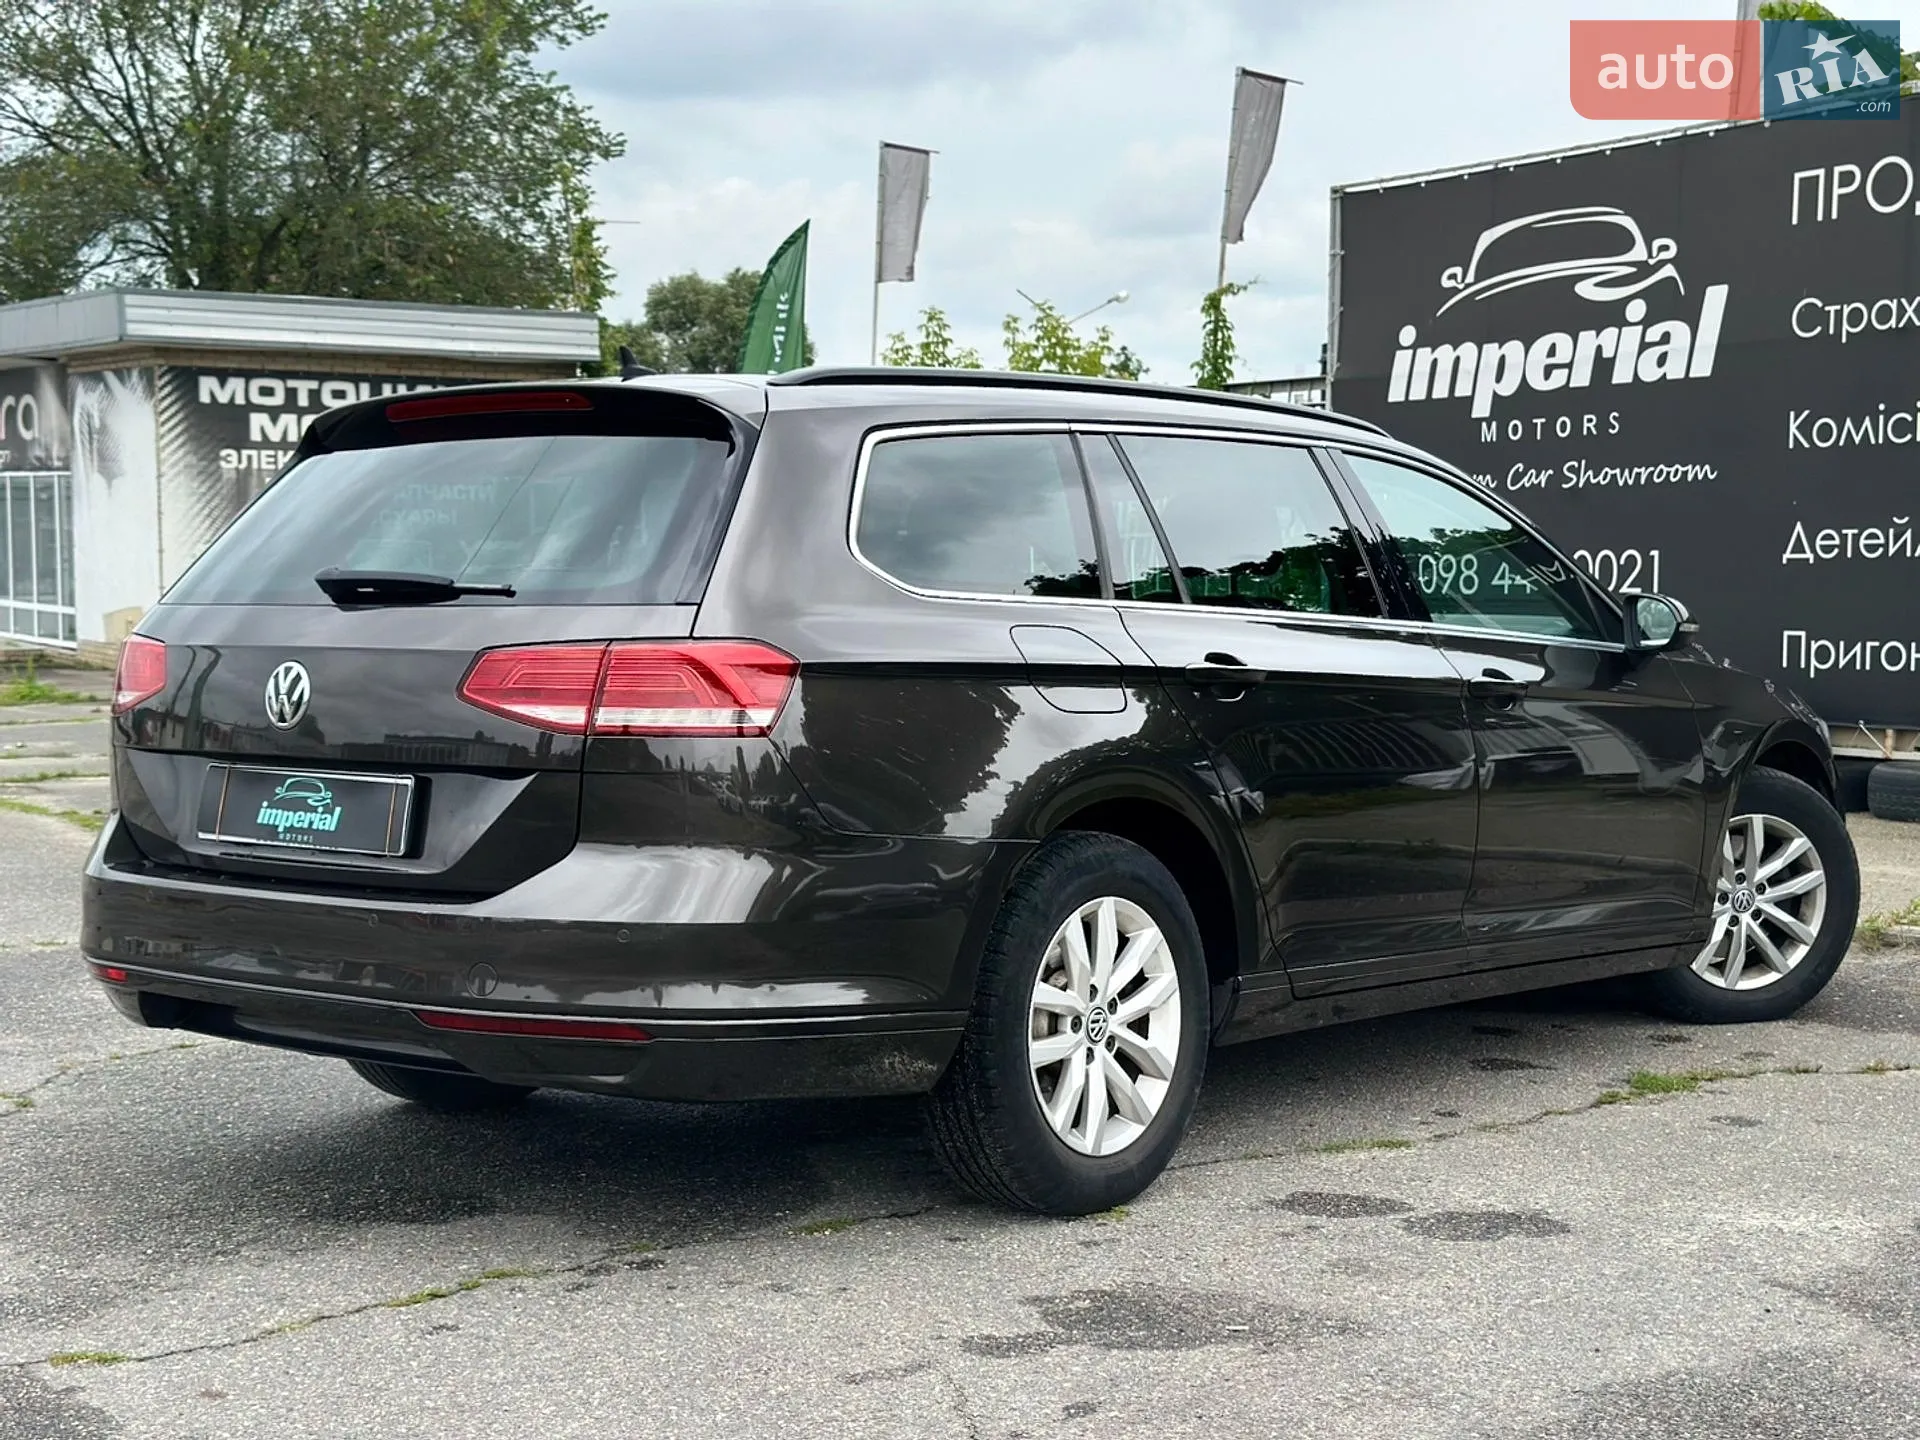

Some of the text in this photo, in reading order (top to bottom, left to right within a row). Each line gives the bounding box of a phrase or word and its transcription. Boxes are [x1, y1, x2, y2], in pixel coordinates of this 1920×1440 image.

[1791, 155, 1920, 226] ПРО
[1791, 296, 1920, 344] Страх
[1387, 284, 1729, 418] imperial
[1481, 411, 1621, 443] MOTORS
[1506, 462, 1554, 491] Car
[1561, 459, 1718, 489] Showroom
[1782, 516, 1920, 564] Детей
[1418, 554, 1480, 596] 098
[256, 800, 342, 832] imperial
